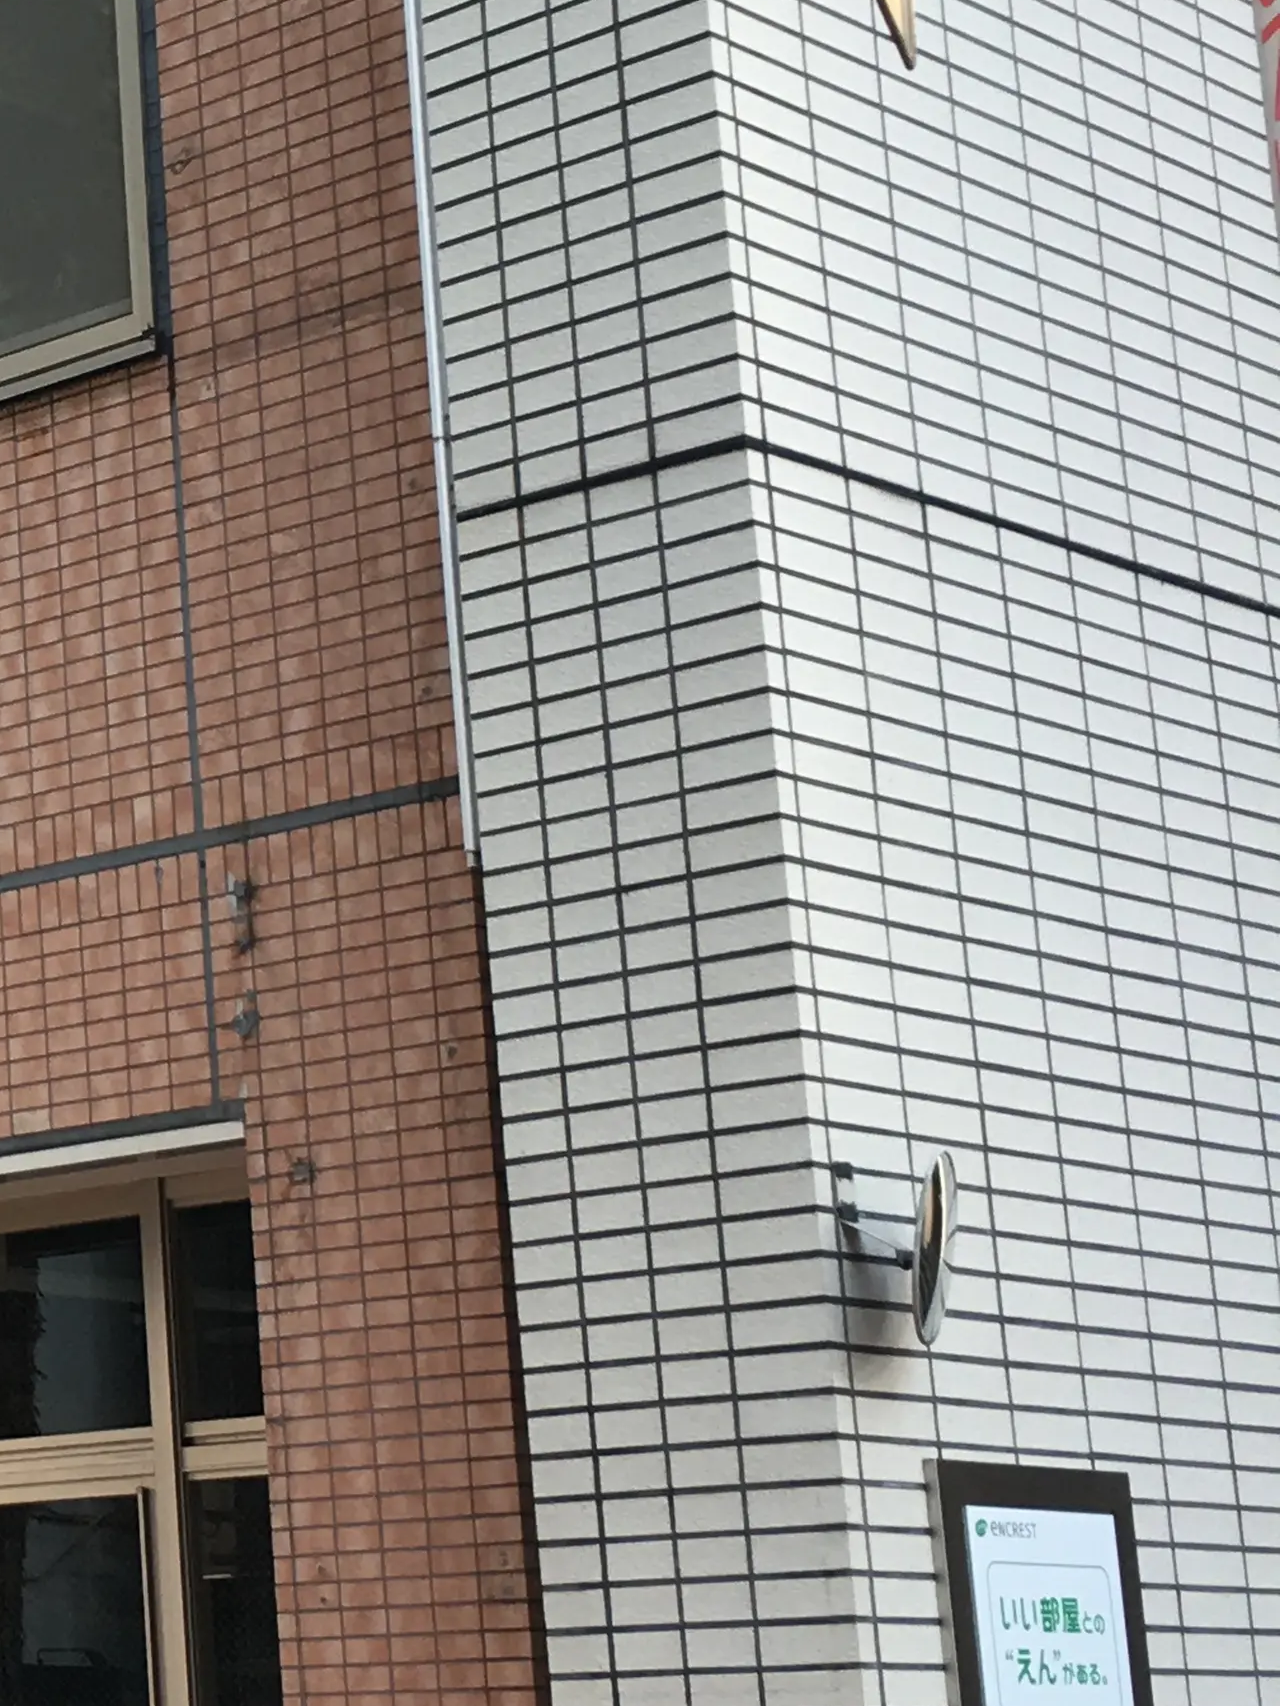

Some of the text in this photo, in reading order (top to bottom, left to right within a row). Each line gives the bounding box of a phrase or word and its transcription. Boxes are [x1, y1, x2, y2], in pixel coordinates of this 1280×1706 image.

[999, 1595, 1106, 1636] いい部屋との
